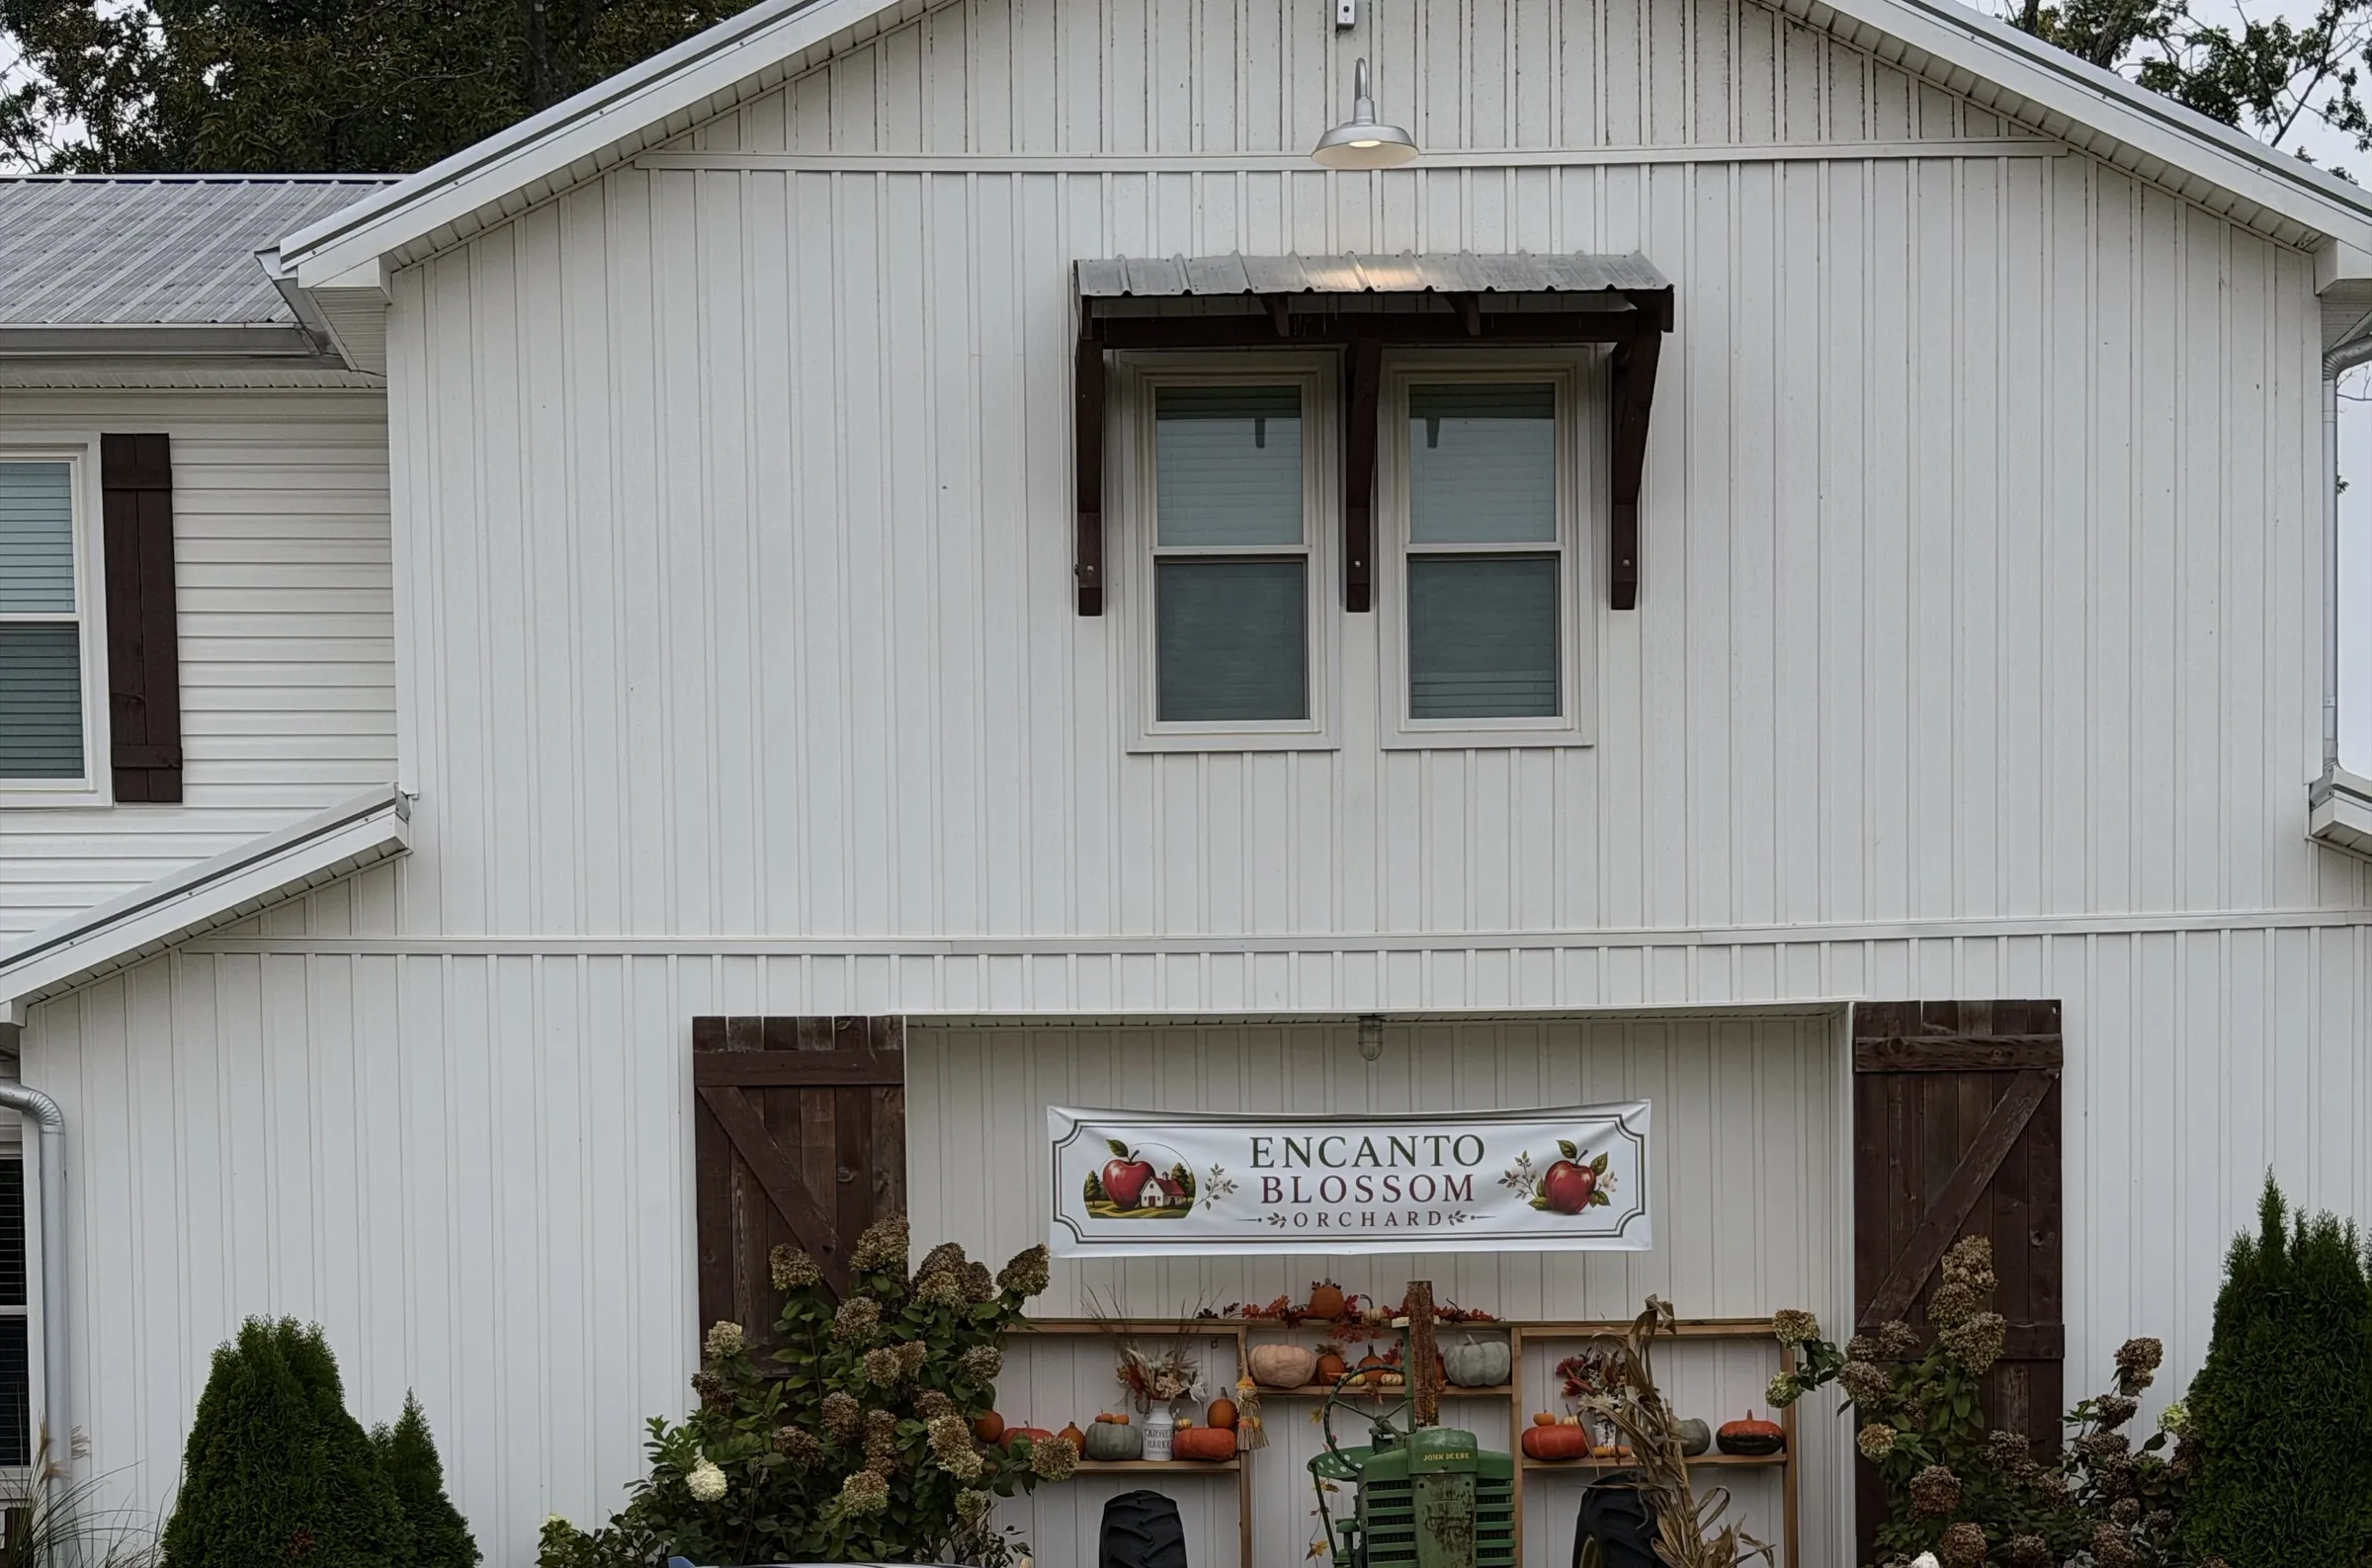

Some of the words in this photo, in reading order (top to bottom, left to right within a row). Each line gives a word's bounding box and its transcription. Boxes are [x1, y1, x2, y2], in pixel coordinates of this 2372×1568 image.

[1249, 1134, 1484, 1168] ENCANTO
[1260, 1174, 1475, 1204] BLOSSOM
[1294, 1210, 1442, 1228] ORCHARD
